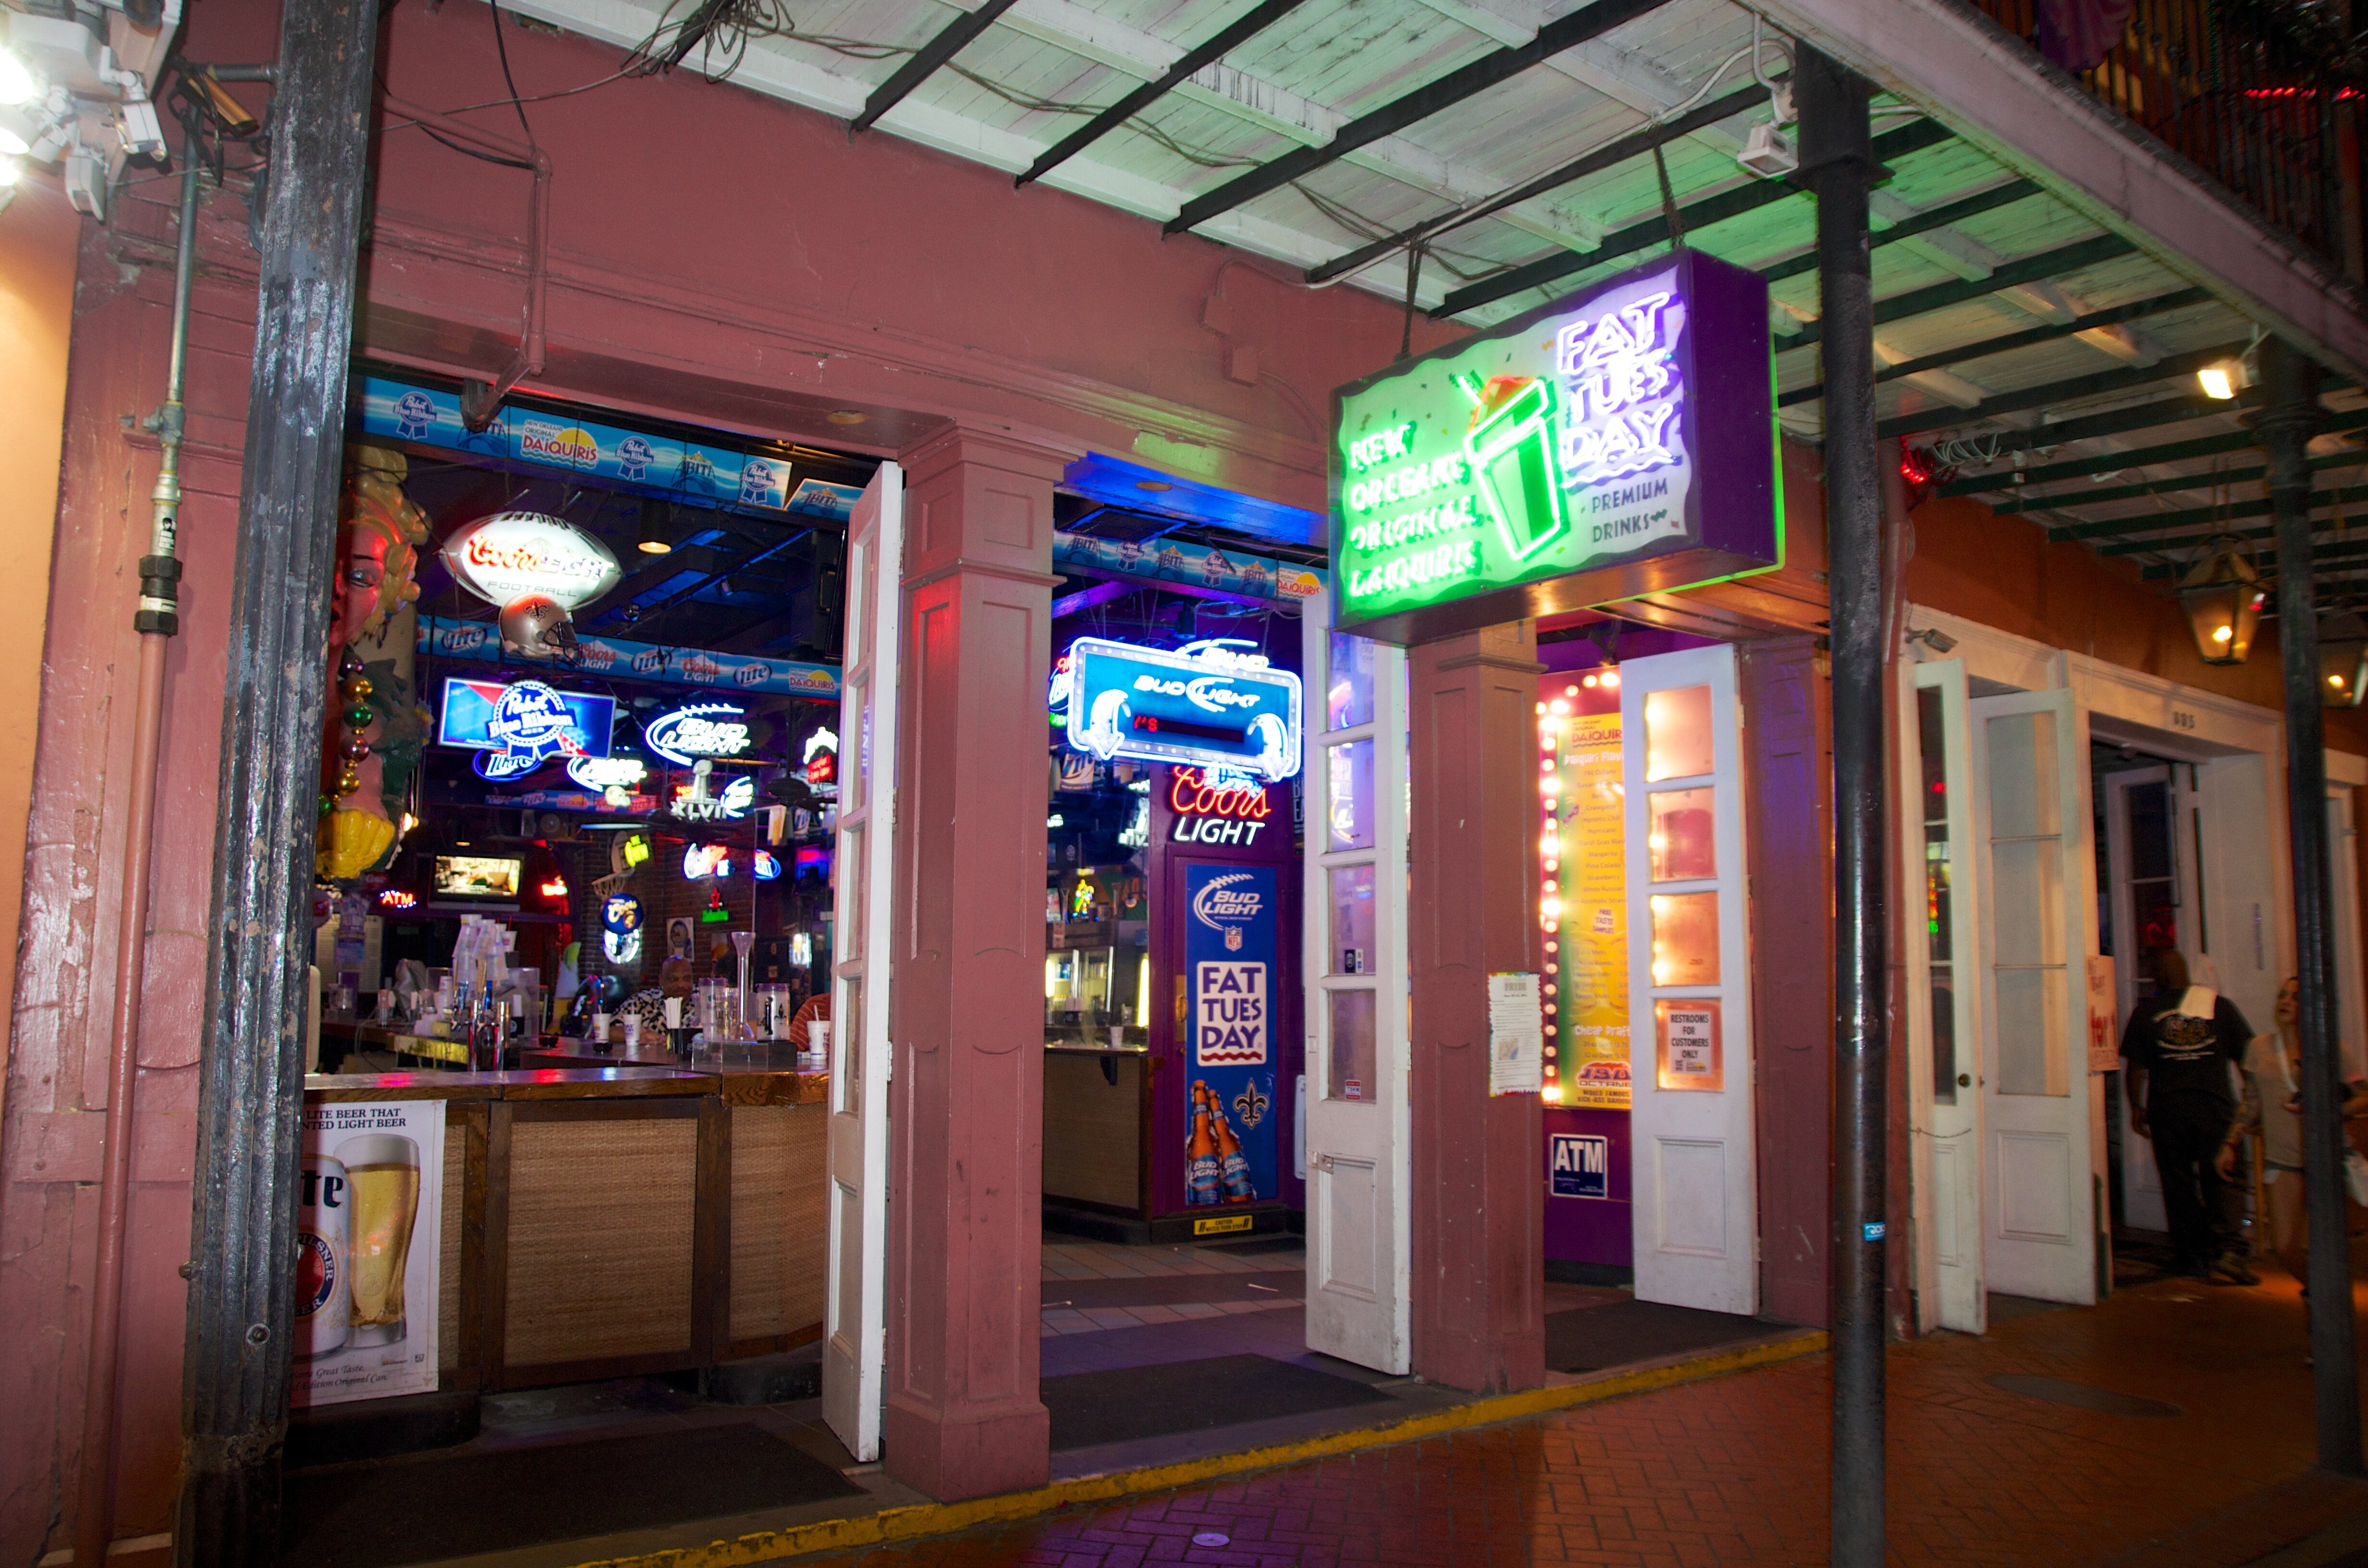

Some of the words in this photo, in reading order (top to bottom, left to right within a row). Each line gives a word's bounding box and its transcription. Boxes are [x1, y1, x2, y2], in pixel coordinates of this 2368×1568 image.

[1557, 292, 1677, 375] FAT
[1567, 349, 1677, 422] TUES
[1349, 421, 1417, 473] NEW
[1560, 403, 1677, 472] DAY
[1592, 478, 1668, 513] PREMIUM
[1593, 513, 1650, 542] DRINKS
[468, 534, 541, 573] Coors
[487, 580, 578, 597] FOOTBALL
[1134, 674, 1186, 696] BUD
[1196, 685, 1260, 708] LIGHT
[506, 693, 548, 715] Pabst
[488, 718, 521, 738] Blue
[521, 710, 574, 729] Ribbon
[521, 726, 545, 735] BEER
[1601, 751, 1623, 762] Flav
[1172, 765, 1272, 819] Coors
[1174, 817, 1266, 845] LIGHT
[382, 893, 413, 905] ATM
[1203, 901, 1264, 915] LIGHT
[1213, 890, 1260, 904] BUD
[1592, 925, 1614, 934] SAMPLES
[1596, 917, 1614, 925] TASTE
[1228, 937, 1240, 945] NFL
[1202, 967, 1262, 993] FAT
[1205, 998, 1262, 1022] TUES
[1671, 1014, 1709, 1023] RESTROOMS
[1201, 1025, 1262, 1050] DAY
[1683, 1026, 1696, 1035] FOR
[1671, 1038, 1709, 1047] CUSTOMERS
[1682, 1050, 1698, 1059] ONLY
[306, 1110, 333, 1120] LITE
[336, 1109, 367, 1119] BEER
[370, 1108, 401, 1117] THAT
[338, 1119, 374, 1129] LIGHT
[376, 1118, 407, 1128] BEER
[1554, 1140, 1603, 1173] ATM
